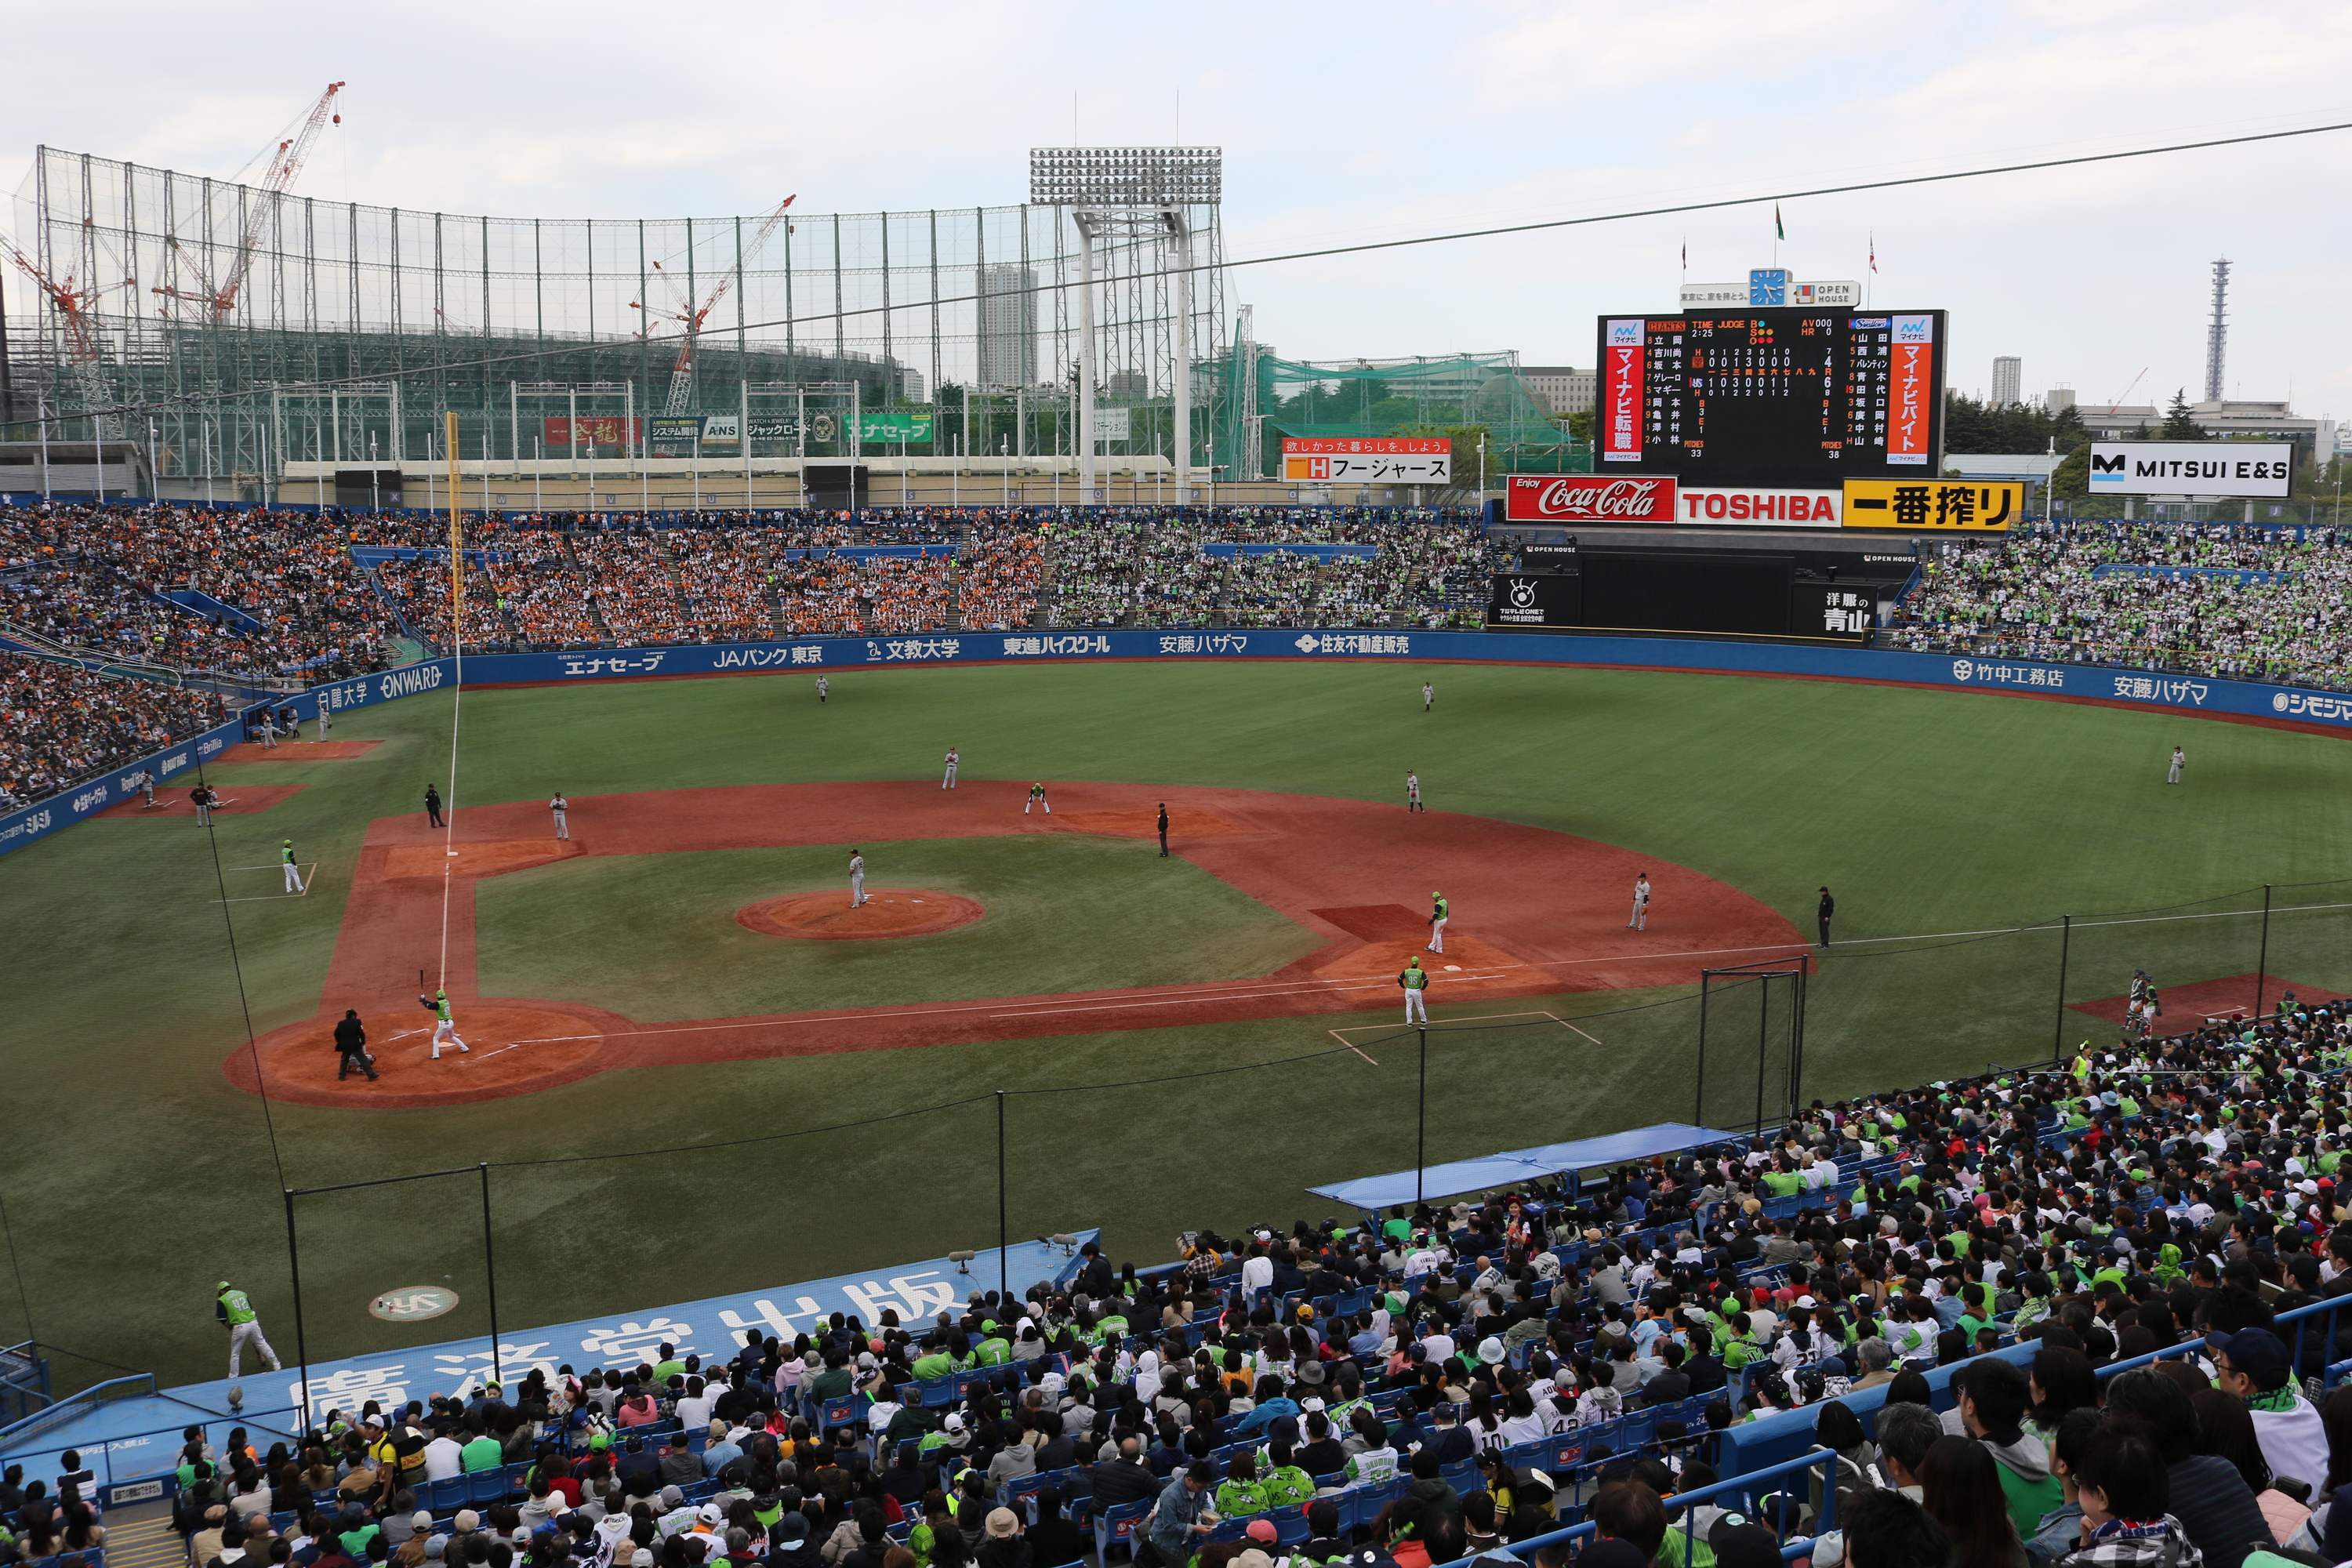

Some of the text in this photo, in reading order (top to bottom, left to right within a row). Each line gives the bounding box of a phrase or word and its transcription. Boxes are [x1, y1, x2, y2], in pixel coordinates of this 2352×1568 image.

[1818, 285, 1849, 294] OPEN
[1680, 292, 1748, 301] 東京に、家を持とう。
[1649, 321, 1685, 331] GIANTS
[1856, 318, 1886, 328] Swallows
[1751, 328, 1757, 336] S
[1859, 333, 1887, 343] 山田
[1654, 348, 1681, 358] 吉川尚
[1654, 361, 1681, 370] 坂本
[1709, 356, 1831, 367] 0 0 1 3 0 0 0 4
[1857, 359, 1887, 368] バレンティン
[1653, 373, 1680, 382] ゲレーロ
[1709, 376, 1831, 388] 1 0 3 0 0 1 1 6
[1857, 372, 1886, 382] 青木
[1654, 385, 1681, 394] マギー
[1857, 385, 1886, 394] 田代
[1613, 348, 1634, 449] マイナビ転職
[1653, 398, 1680, 407] 岡本
[1856, 397, 1884, 407] 坂口
[1900, 346, 1920, 452] マイナビバイト
[652, 426, 699, 436] システム開発
[748, 424, 811, 435] ジャックロード
[848, 423, 929, 437] エナセーブ
[1856, 423, 1884, 433] 中村
[1286, 441, 1448, 452] 欲しかった暮らしを、しよう。
[1652, 435, 1679, 445] 小林
[1311, 459, 1327, 477] H
[1333, 458, 1446, 479] フージャース
[2136, 461, 2288, 479] MITSUI E&S
[1516, 478, 1541, 488] Enjoy
[1538, 480, 1660, 516] Coca-Cola
[1682, 493, 1835, 522] TOSHIBA
[1853, 486, 2012, 526] 一番搾り
[1826, 592, 1869, 608] 洋服の
[1824, 608, 1871, 633] 青山
[885, 638, 960, 660] 文教大学
[1004, 635, 1111, 655] 東進ハイスクール
[1160, 633, 1247, 653] 安藤ハザマ
[1320, 633, 1410, 654] 住友不動産販売
[713, 646, 823, 668] JAバンク 東京
[565, 655, 663, 675] エナセーブ
[380, 665, 442, 699] ONWARD
[1976, 663, 2064, 688] 竹中工務店
[2114, 677, 2209, 705] 安藤ハザマ
[203, 738, 223, 755] Brillia
[167, 752, 187, 772] BOAT RACE
[232, 1297, 249, 1312] 42
[1365, 1457, 1395, 1470] OKUMURA
